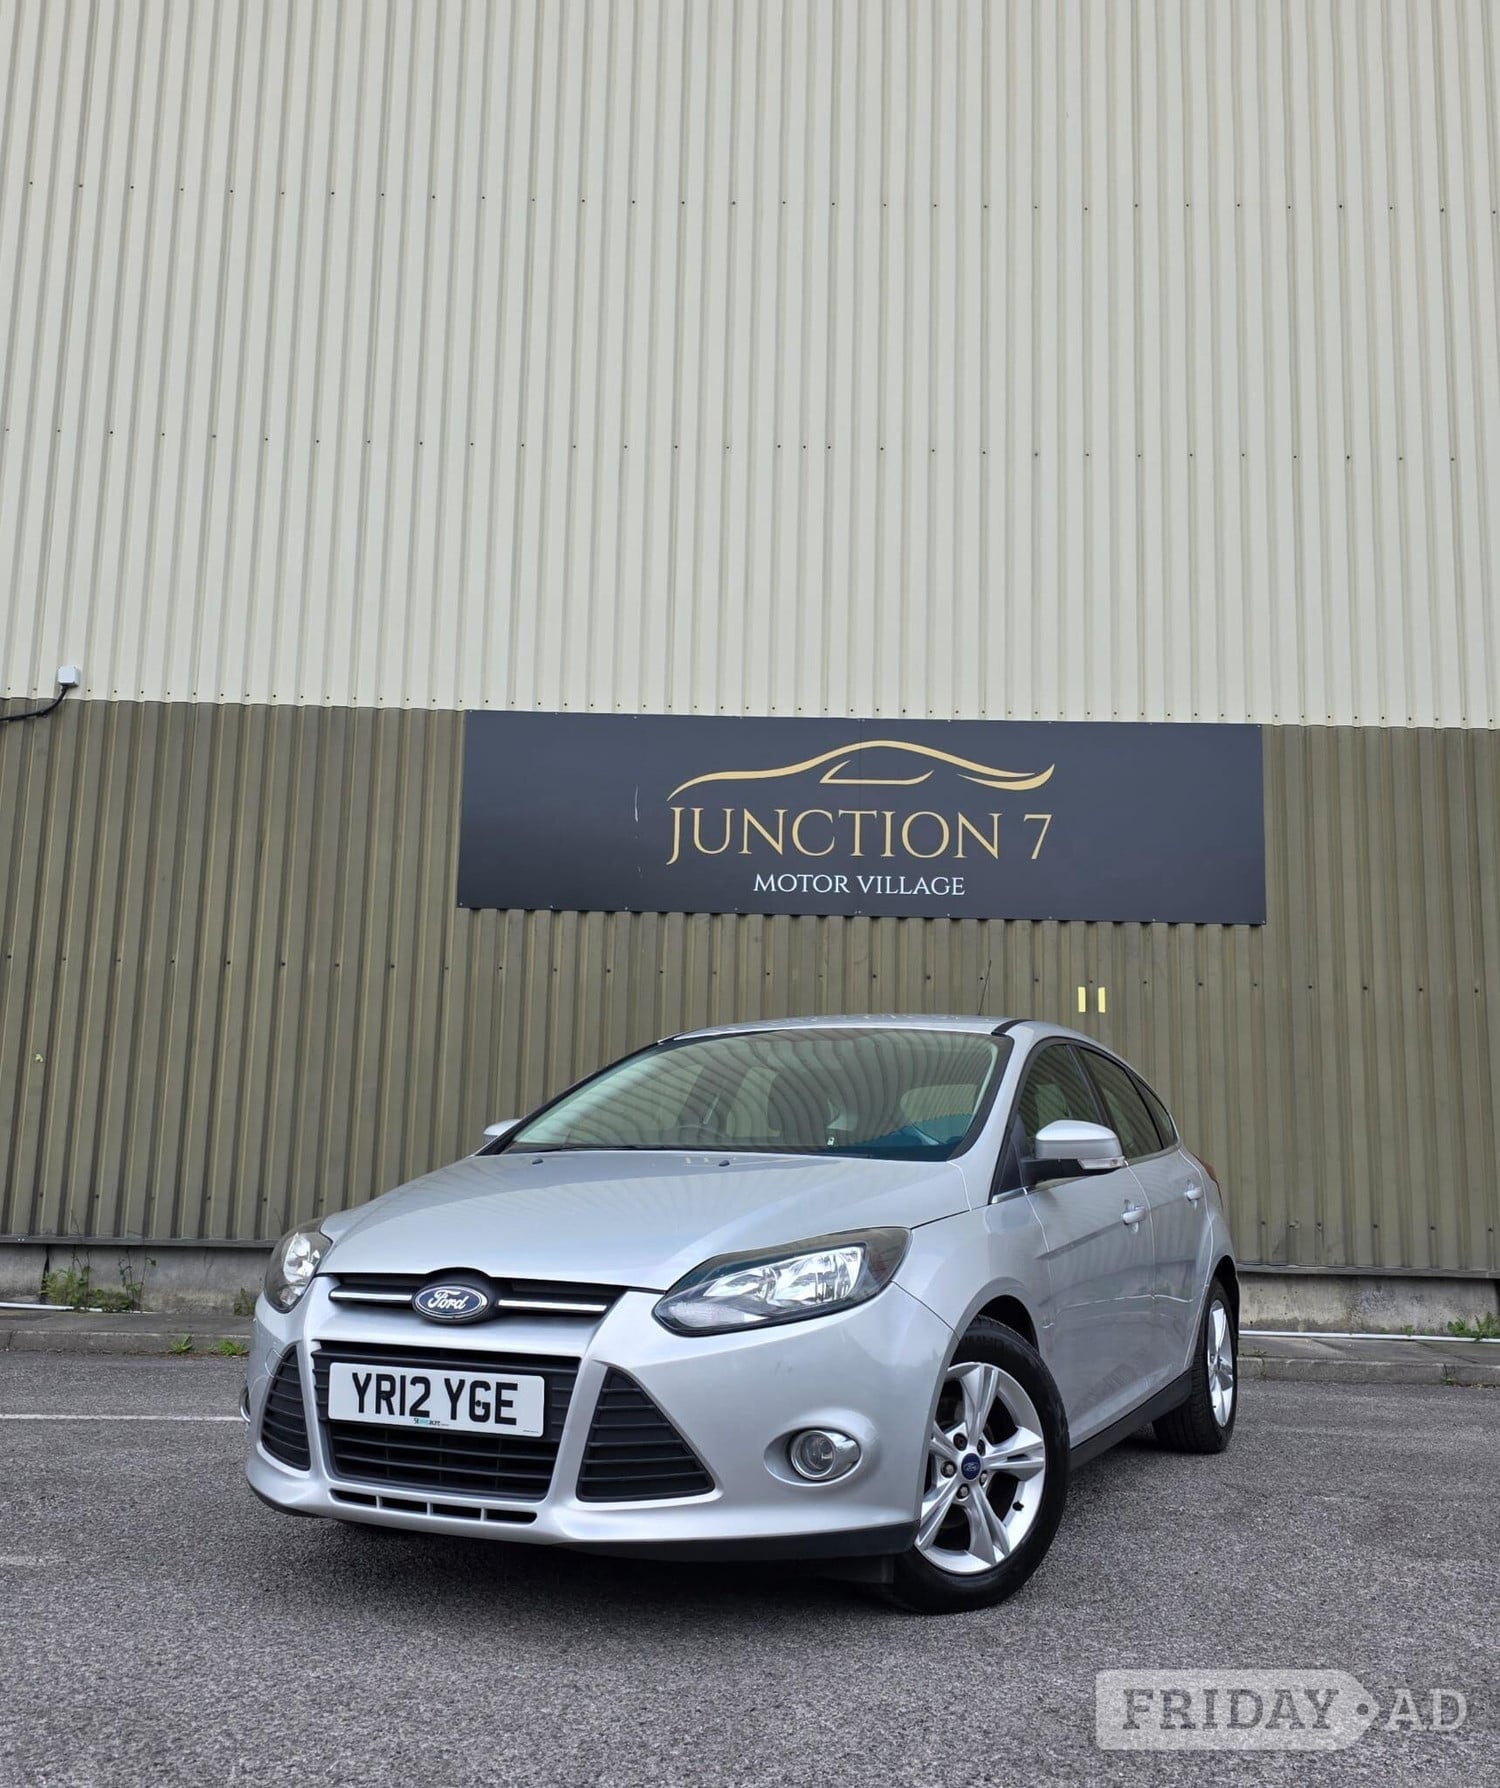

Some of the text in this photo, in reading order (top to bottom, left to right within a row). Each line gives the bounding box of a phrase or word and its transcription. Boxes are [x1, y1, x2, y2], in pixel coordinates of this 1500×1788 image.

[666, 807, 1053, 865] JUNCTION 7
[753, 873, 966, 896] MOTOR VILLAGE
[427, 1289, 468, 1311] Ford
[352, 1372, 518, 1426] YR12 YGE
